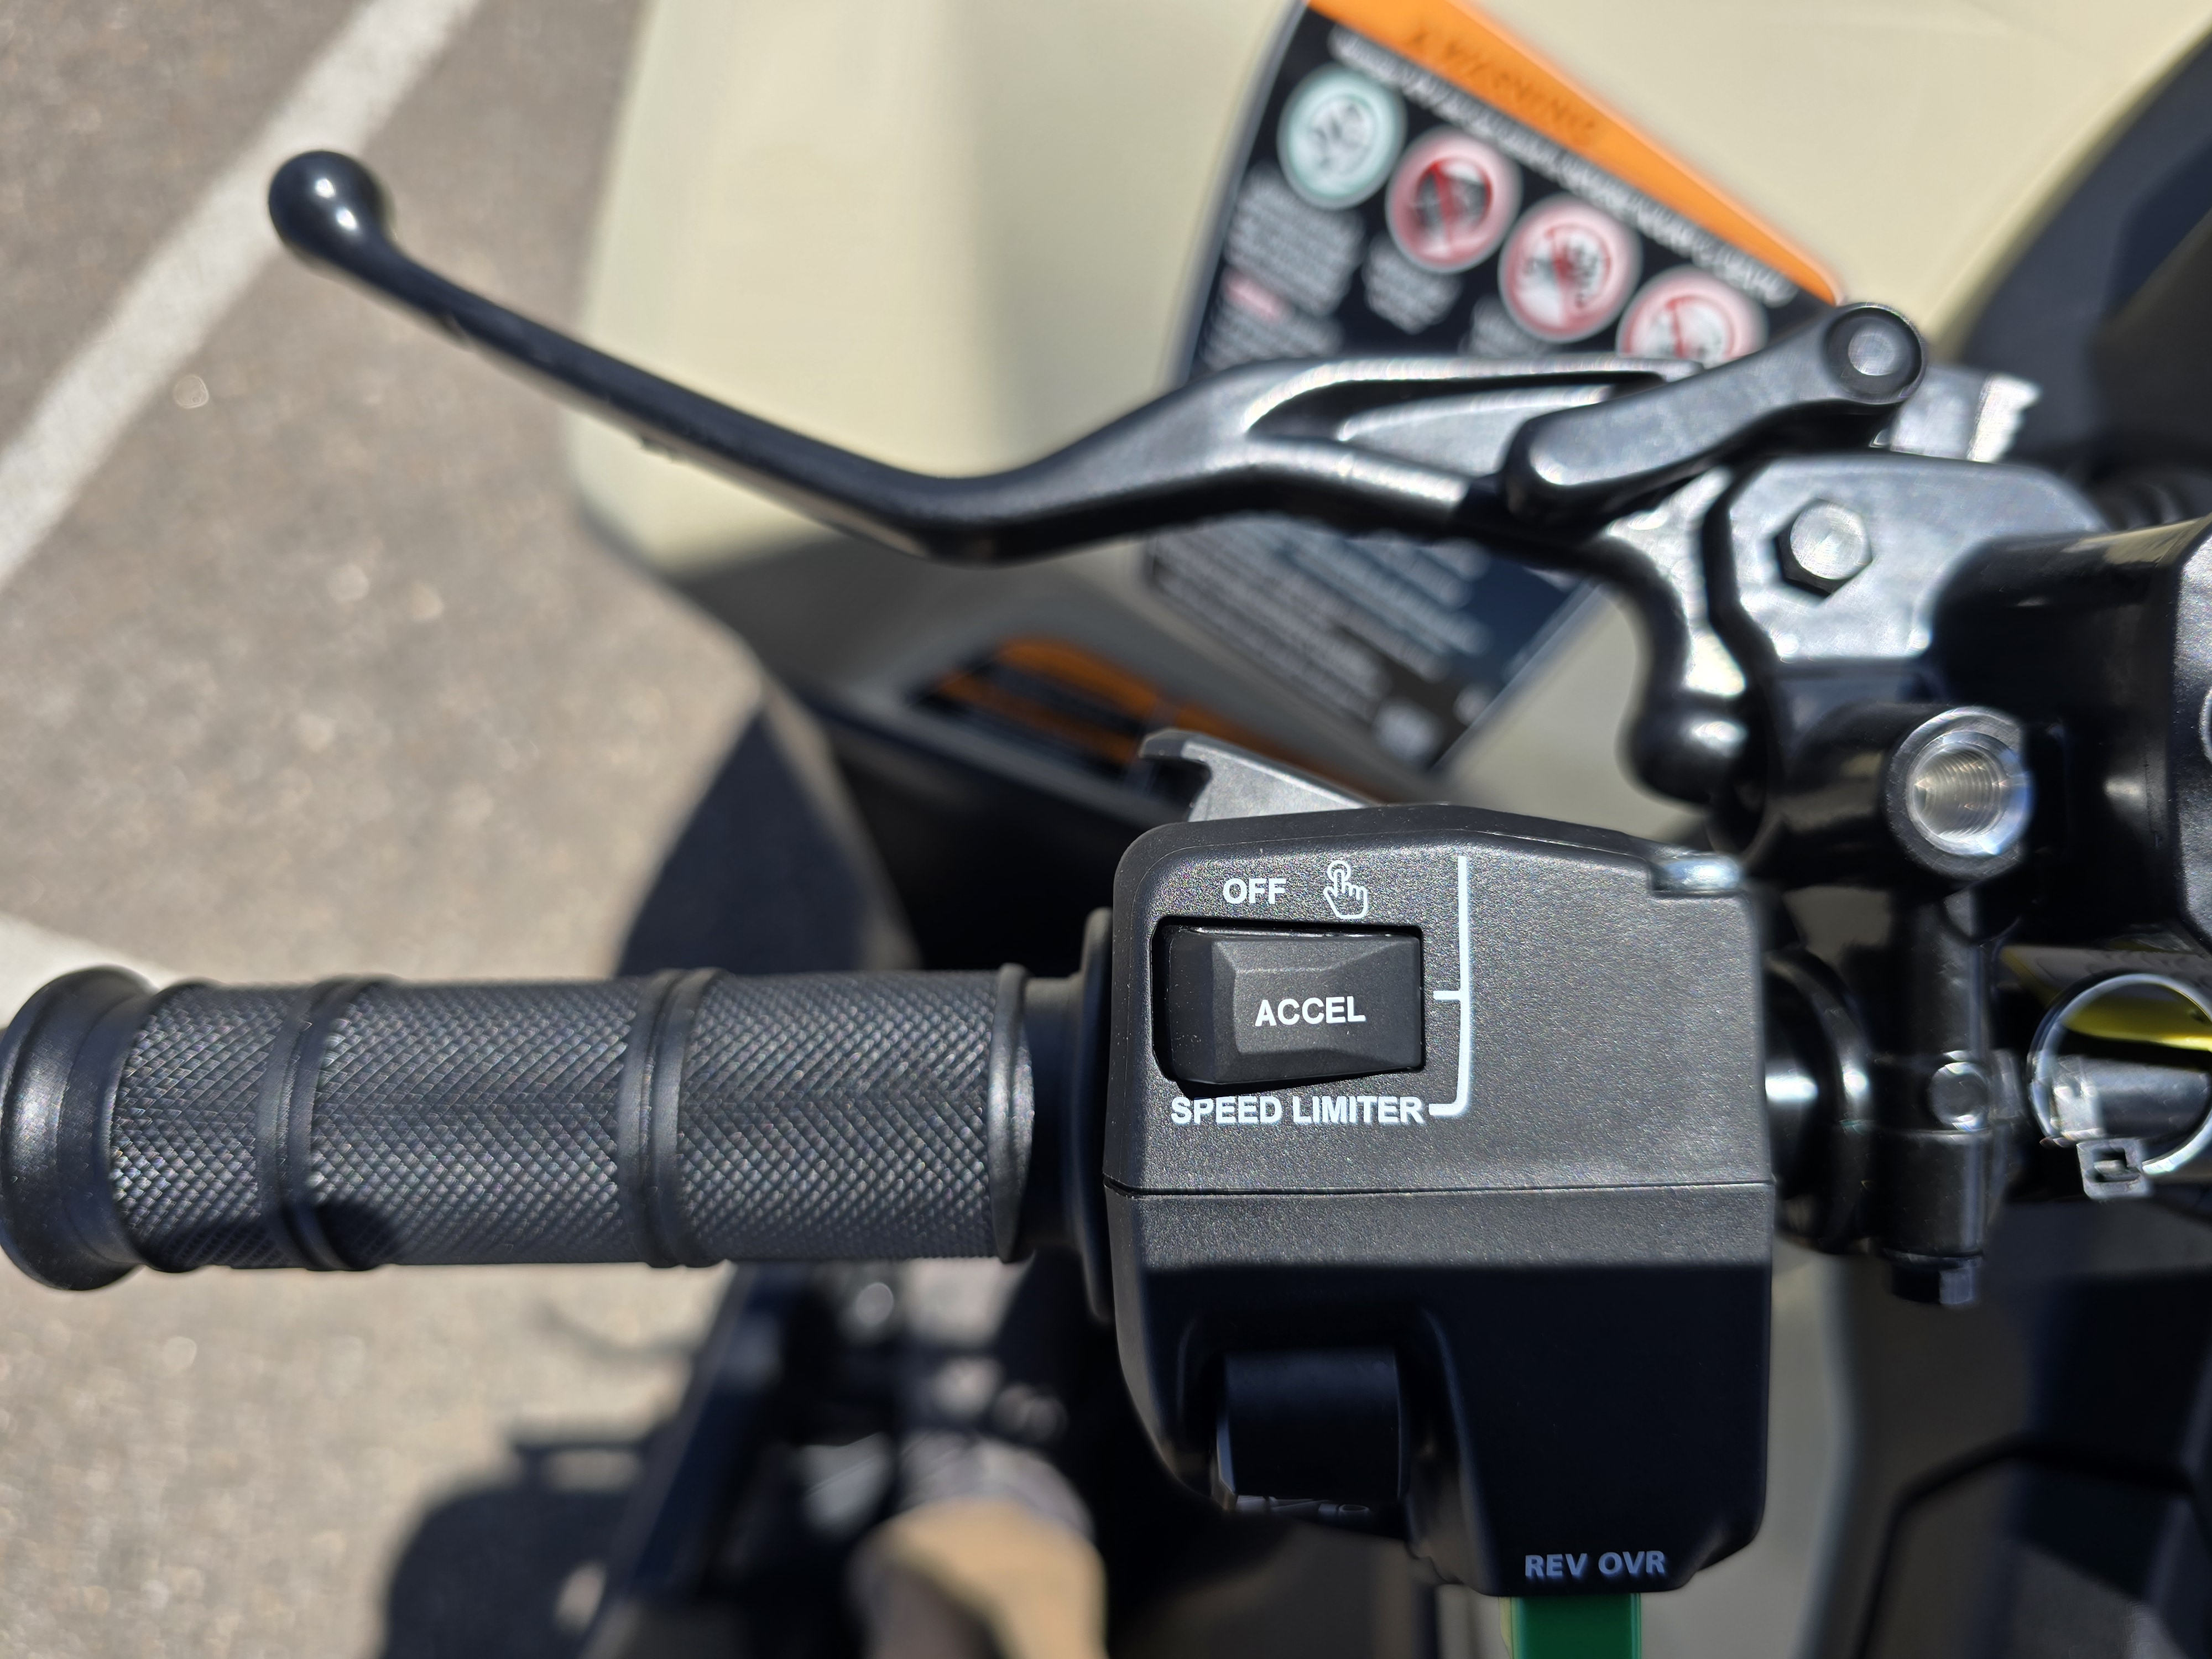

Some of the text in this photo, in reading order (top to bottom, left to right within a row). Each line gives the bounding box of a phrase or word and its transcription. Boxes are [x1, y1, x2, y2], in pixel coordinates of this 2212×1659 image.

[1223, 878, 1287, 904] OFF
[1254, 996, 1366, 1026] ACCEL
[1171, 1096, 1424, 1125] SPEED LIMITER
[1525, 1551, 1665, 1577] REV OVR
